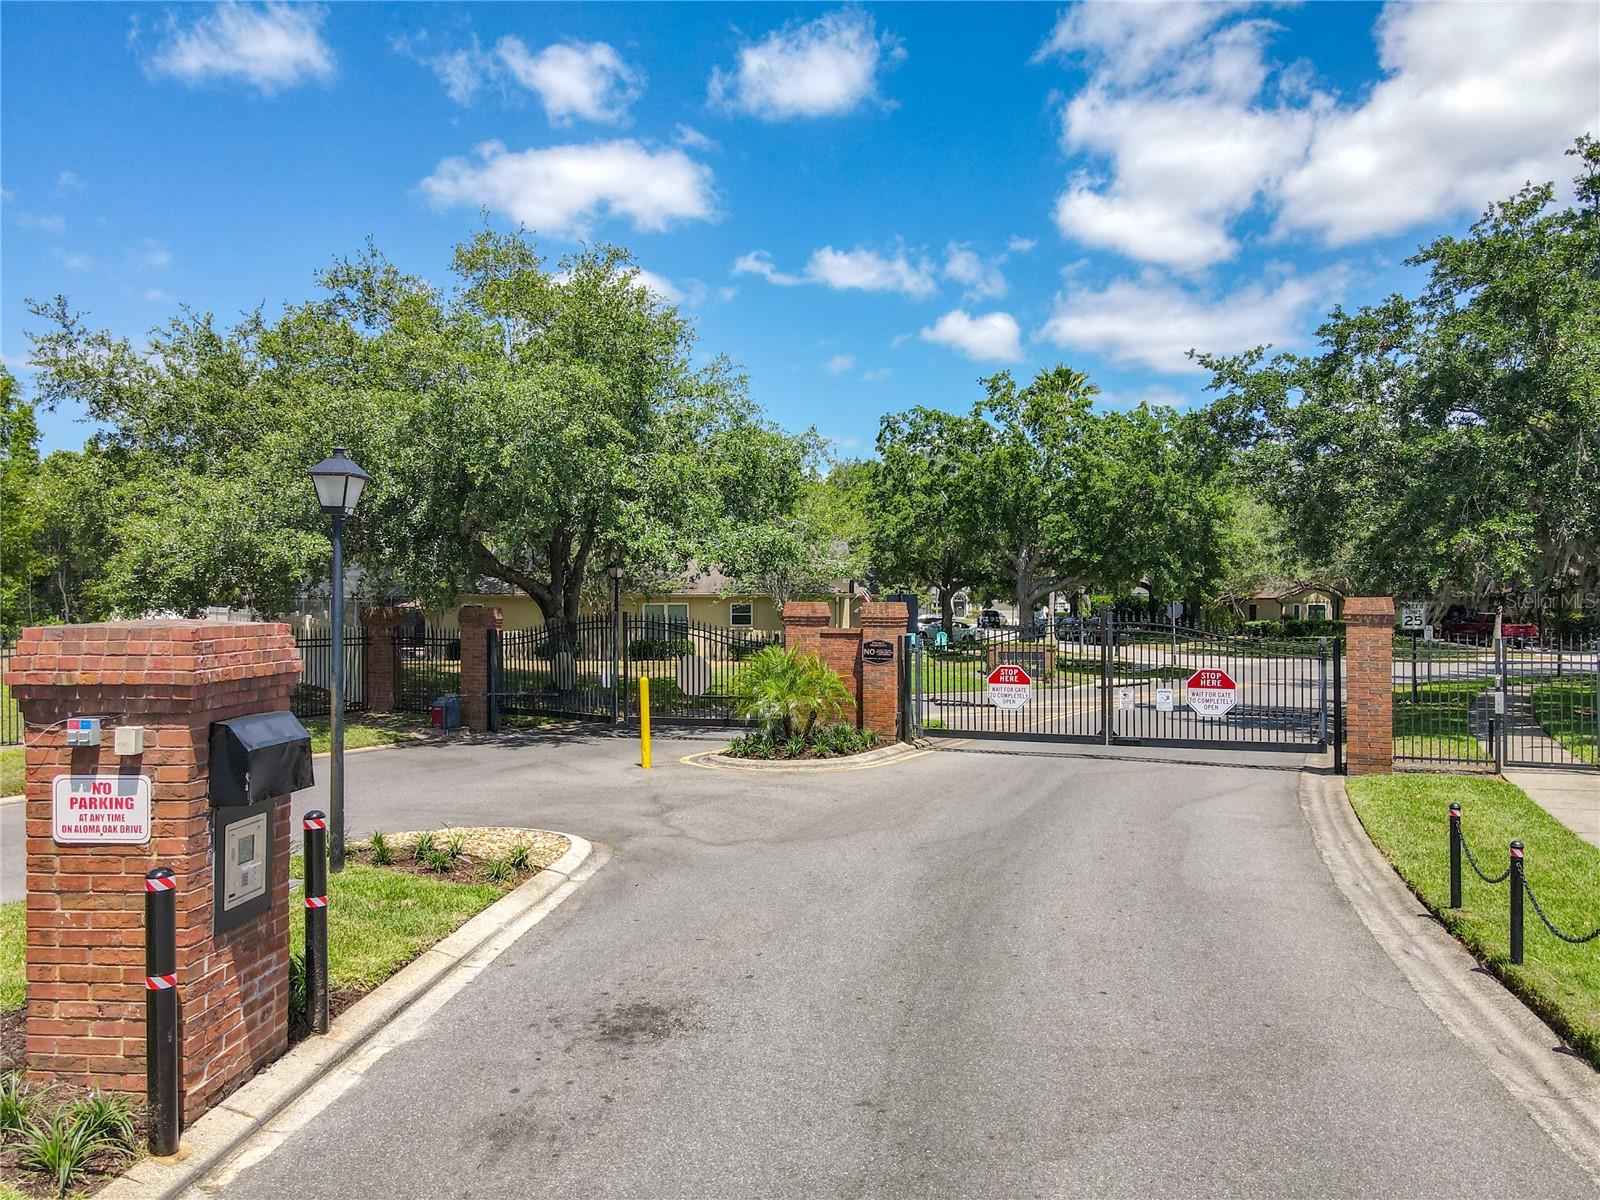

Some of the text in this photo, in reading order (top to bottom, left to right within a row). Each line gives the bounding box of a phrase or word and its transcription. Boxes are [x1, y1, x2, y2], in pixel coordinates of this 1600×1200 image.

[1404, 615, 1423, 626] 25
[864, 648, 876, 656] NO
[1000, 668, 1019, 676] STOP
[1201, 672, 1222, 680] STOP
[999, 675, 1019, 683] HERE
[1200, 679, 1222, 687] HERE
[1197, 697, 1234, 705] COMPLETELY
[92, 782, 112, 795] NO
[69, 796, 135, 810] PARKING
[78, 813, 126, 823] AT ANY TIME
[61, 824, 143, 834] ON ALOMA OAK DRIVE
